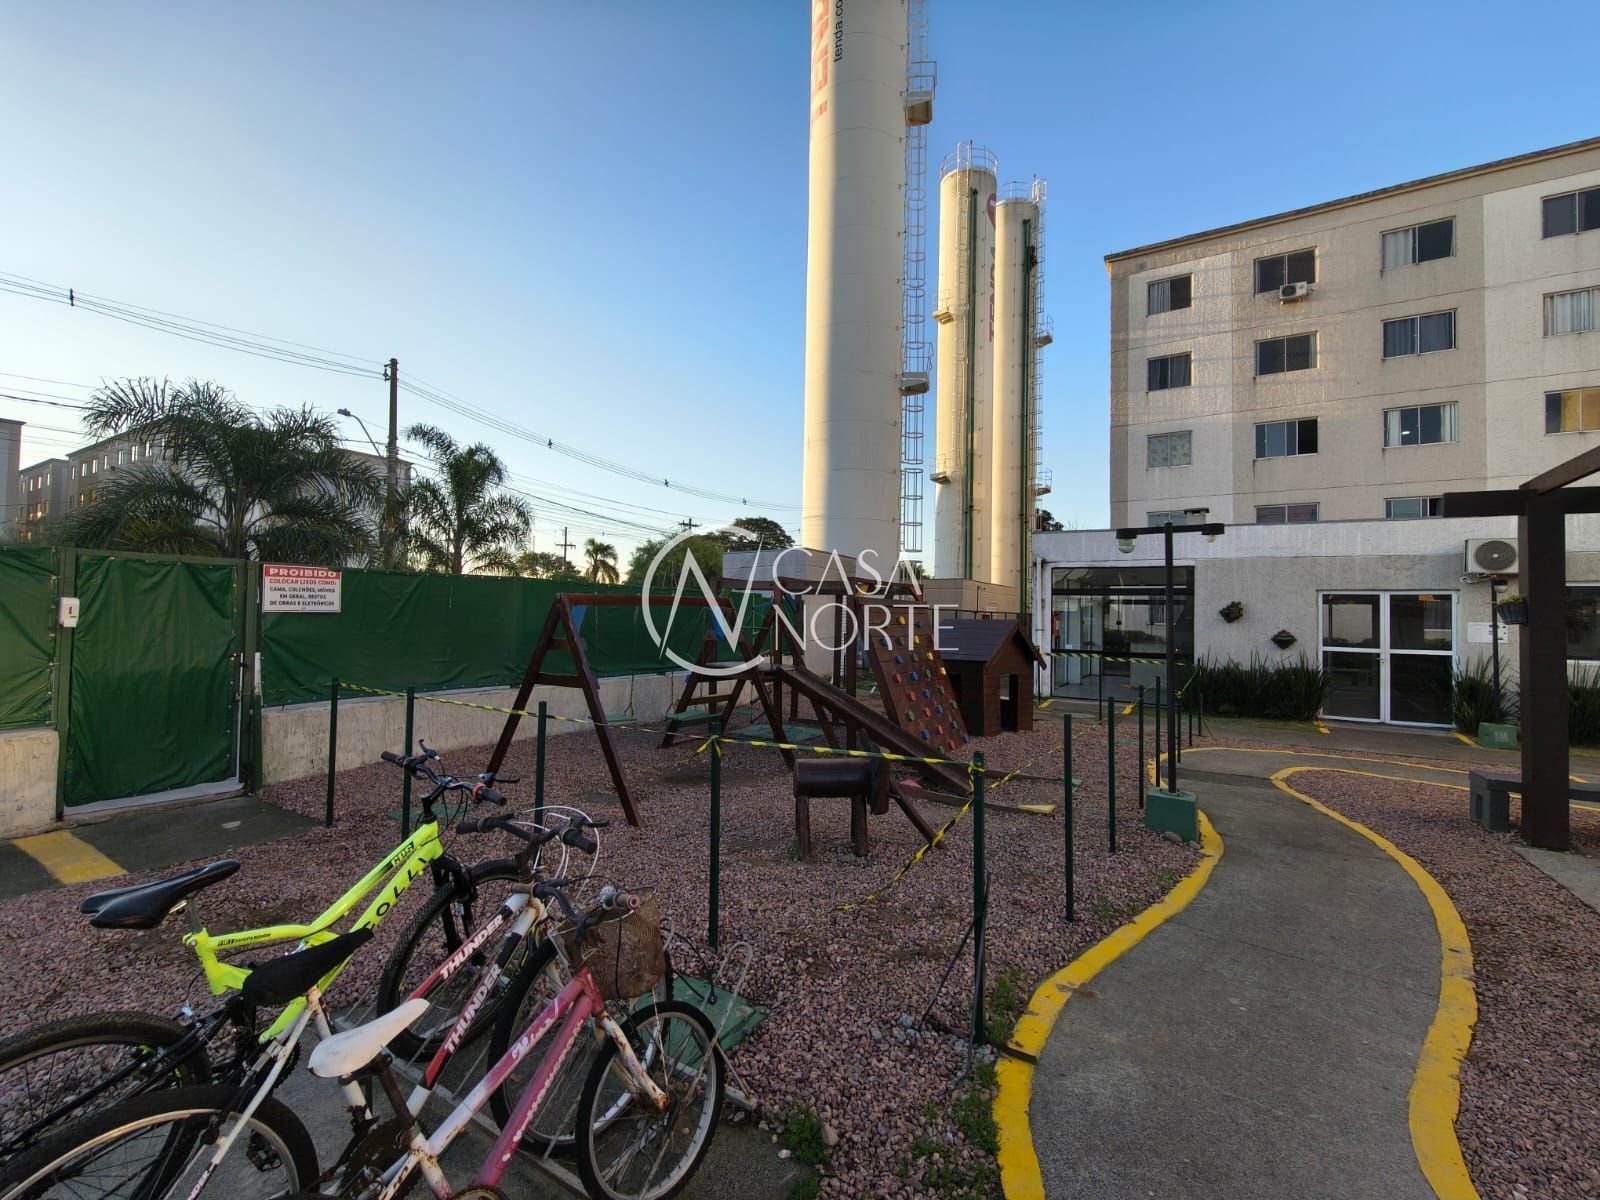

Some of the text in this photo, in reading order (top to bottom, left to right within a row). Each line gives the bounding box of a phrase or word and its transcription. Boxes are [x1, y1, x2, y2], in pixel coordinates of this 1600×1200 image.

[269, 568, 336, 577] PROIBIDO
[439, 914, 504, 980] THUNDER
[444, 962, 500, 1054] THUNDER
